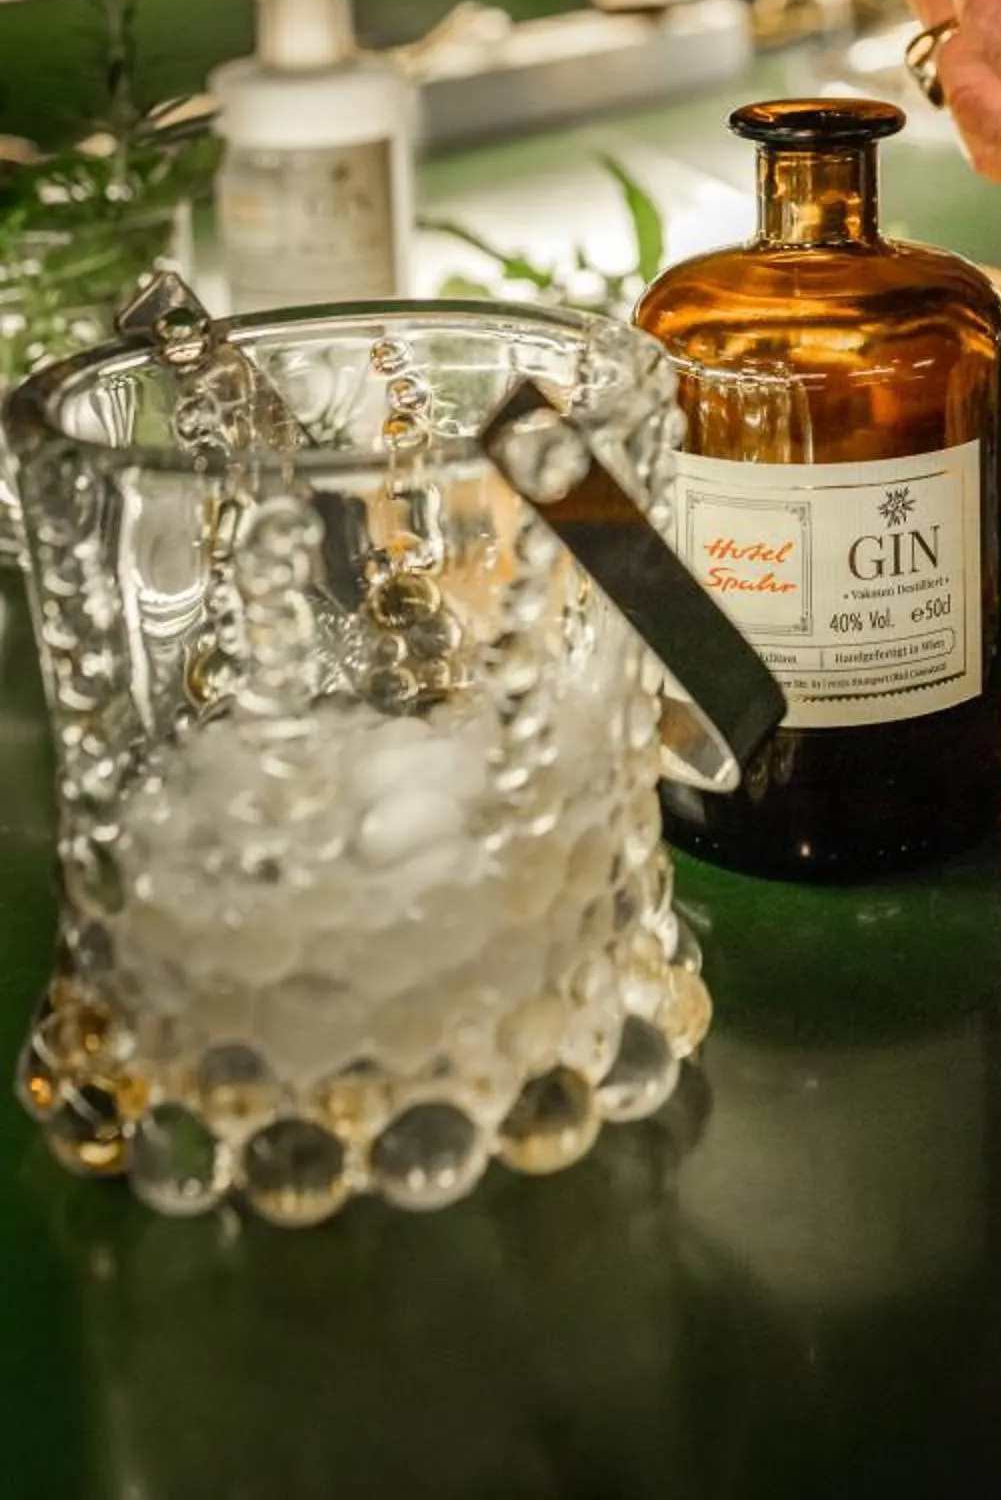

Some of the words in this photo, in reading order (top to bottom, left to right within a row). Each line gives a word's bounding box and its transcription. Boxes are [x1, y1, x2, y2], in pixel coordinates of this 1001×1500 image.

[703, 537, 793, 563] Hotel
[848, 525, 940, 581] GIN
[829, 611, 863, 633] 40%
[869, 606, 895, 629] Vol.
